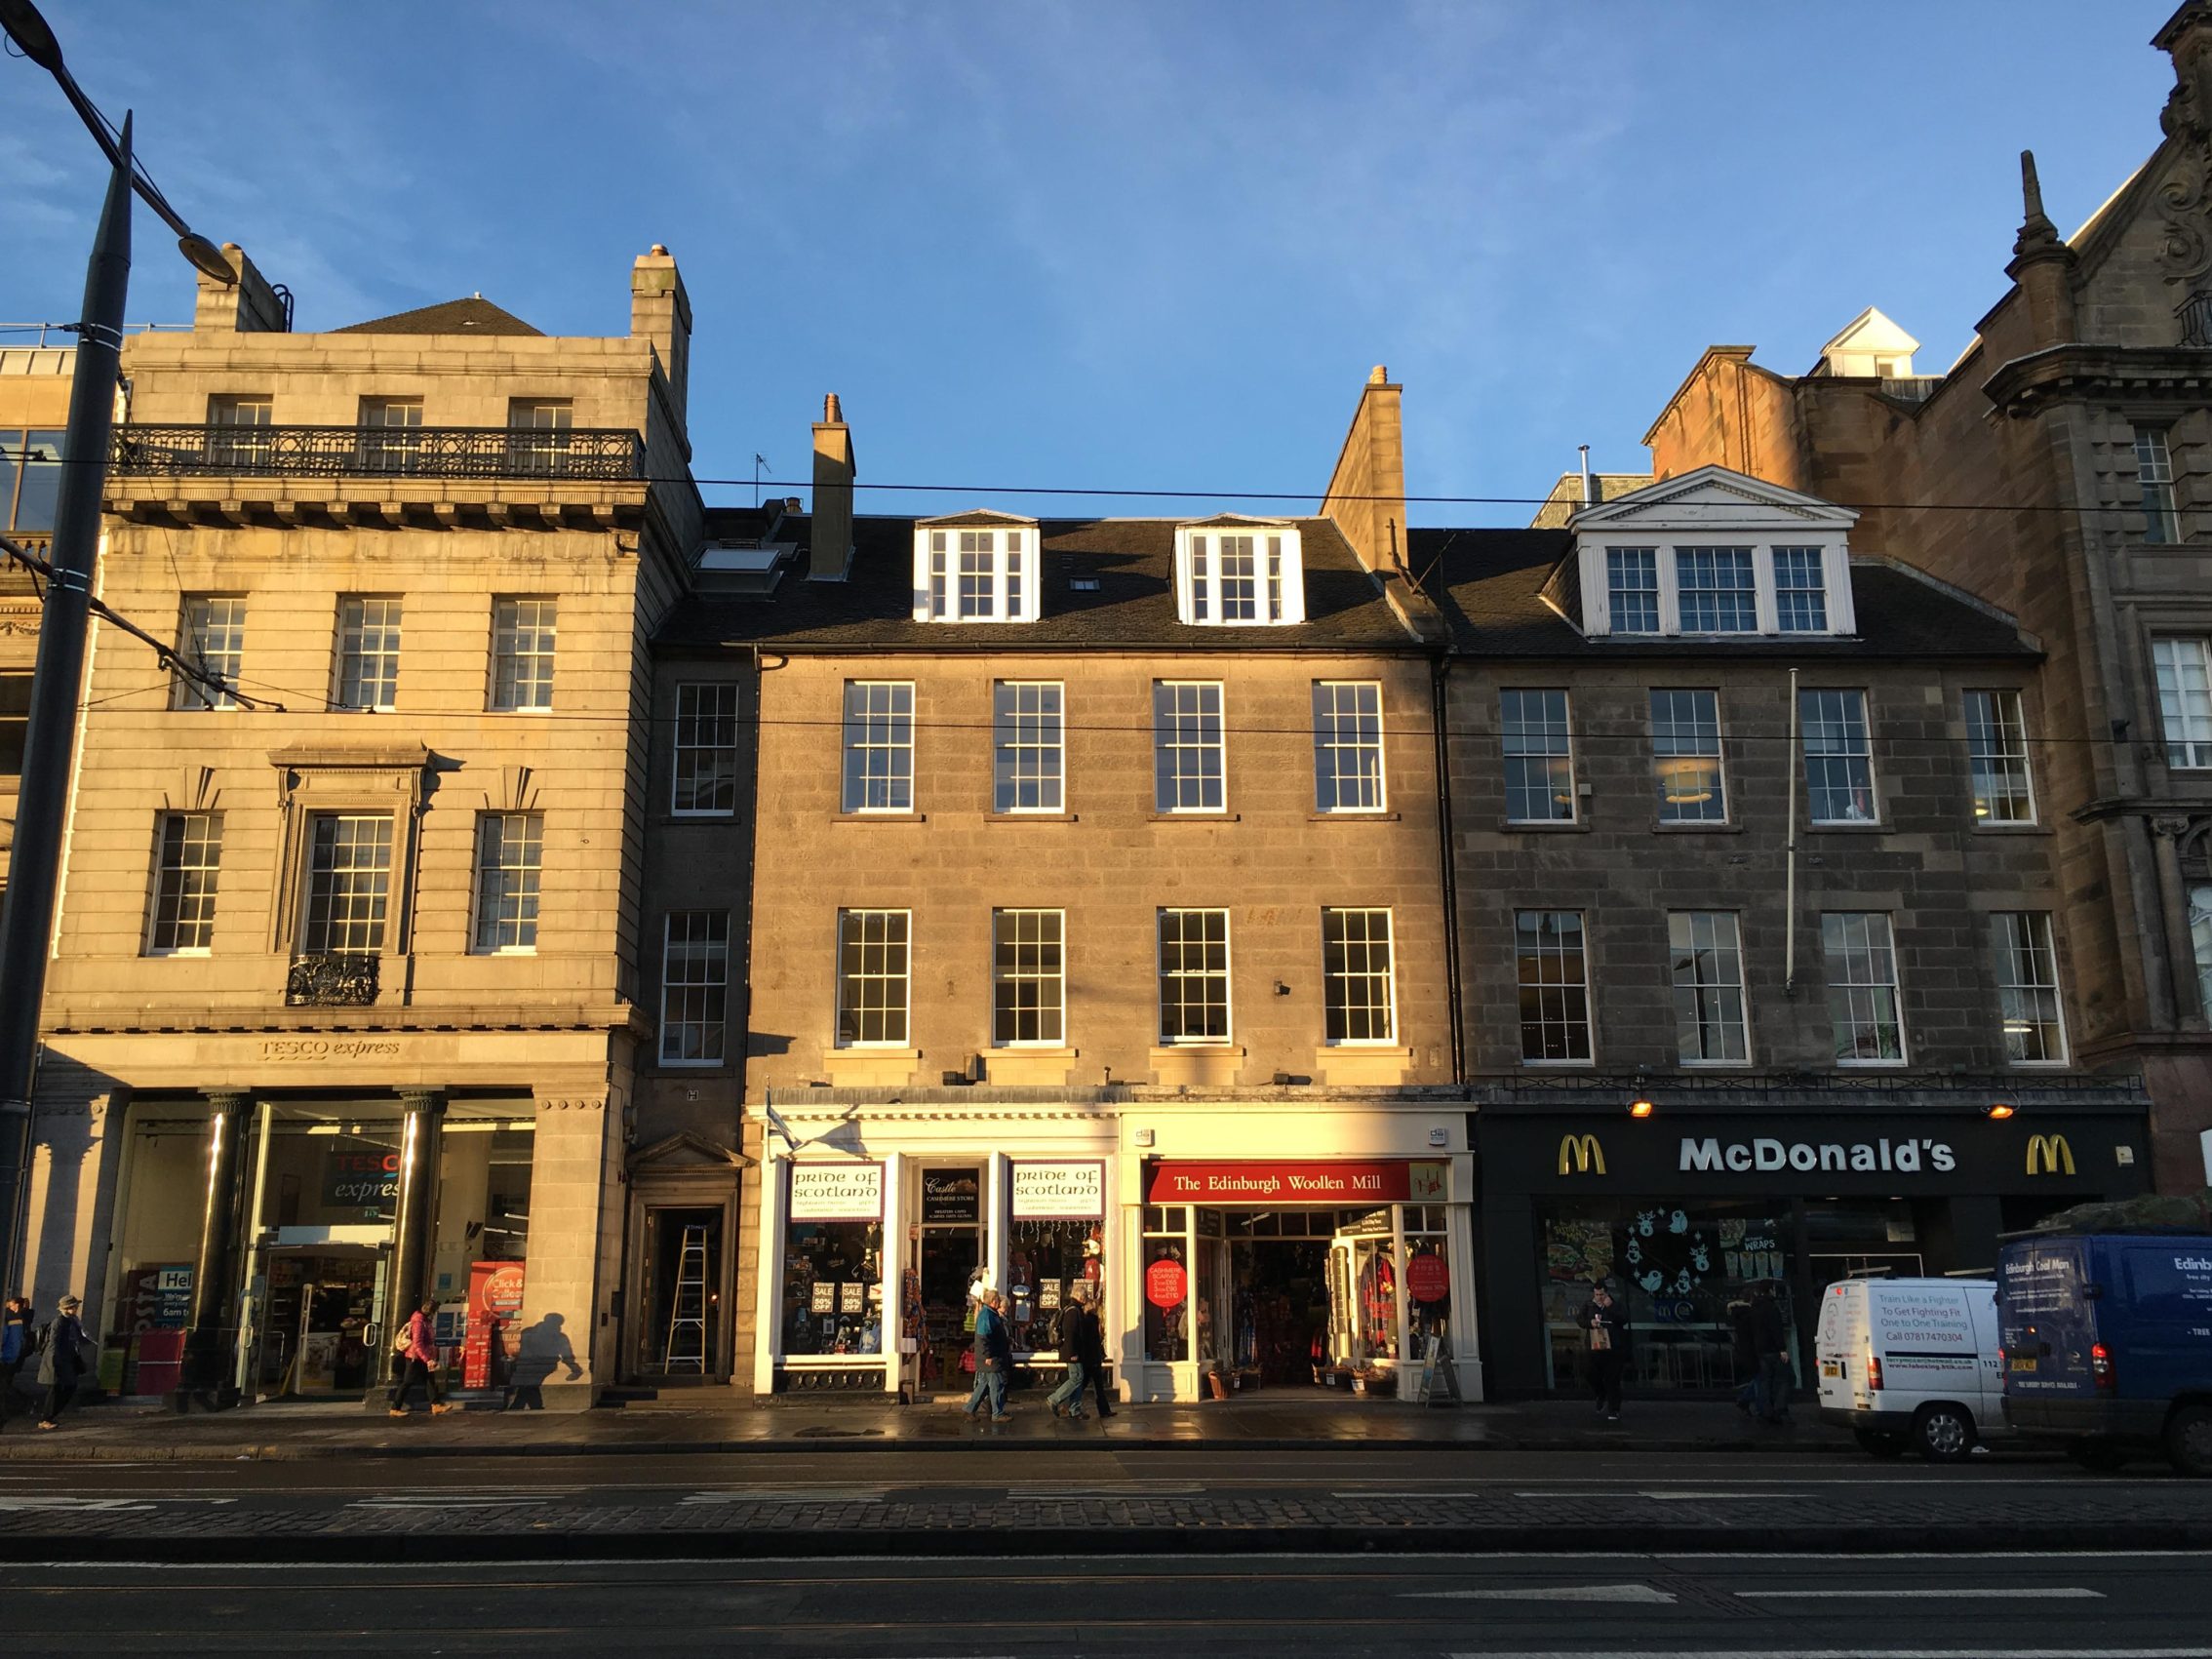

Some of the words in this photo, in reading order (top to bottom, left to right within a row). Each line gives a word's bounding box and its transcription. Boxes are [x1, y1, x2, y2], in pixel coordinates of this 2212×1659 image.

[257, 1041, 329, 1054] TESCO
[334, 1040, 400, 1058] express
[1679, 1137, 1956, 1172] McDonald's
[336, 1154, 402, 1172] TESC
[1174, 1175, 1202, 1191] The
[1207, 1175, 1281, 1195] Edinburgh
[1288, 1174, 1345, 1191] Woollen
[1352, 1174, 1382, 1191] Mill
[1744, 1239, 1776, 1251] WRAPS
[2005, 1261, 2034, 1275] Edinburgh
[2035, 1258, 2050, 1272] Coal
[2051, 1257, 2070, 1270] Man
[815, 1287, 833, 1296] SALE
[844, 1287, 862, 1296] SALE
[1043, 1283, 1060, 1292] SALE
[1879, 1294, 1901, 1304] Train
[1902, 1295, 1920, 1304] Like
[1929, 1295, 1958, 1306] Fighter
[1882, 1307, 1893, 1316] To
[1894, 1307, 1911, 1316] Get
[1912, 1307, 1949, 1318] Fighting
[1950, 1307, 1961, 1317] Fit
[1880, 1319, 1900, 1327] One
[1902, 1319, 1911, 1327] to
[1912, 1319, 1931, 1327] One
[1932, 1319, 1968, 1330] Training
[1886, 1332, 1903, 1341] Call
[1904, 1332, 1962, 1342] 07817470304
[2192, 1327, 2211, 1336] TREE
[1983, 1360, 1998, 1368] 112
